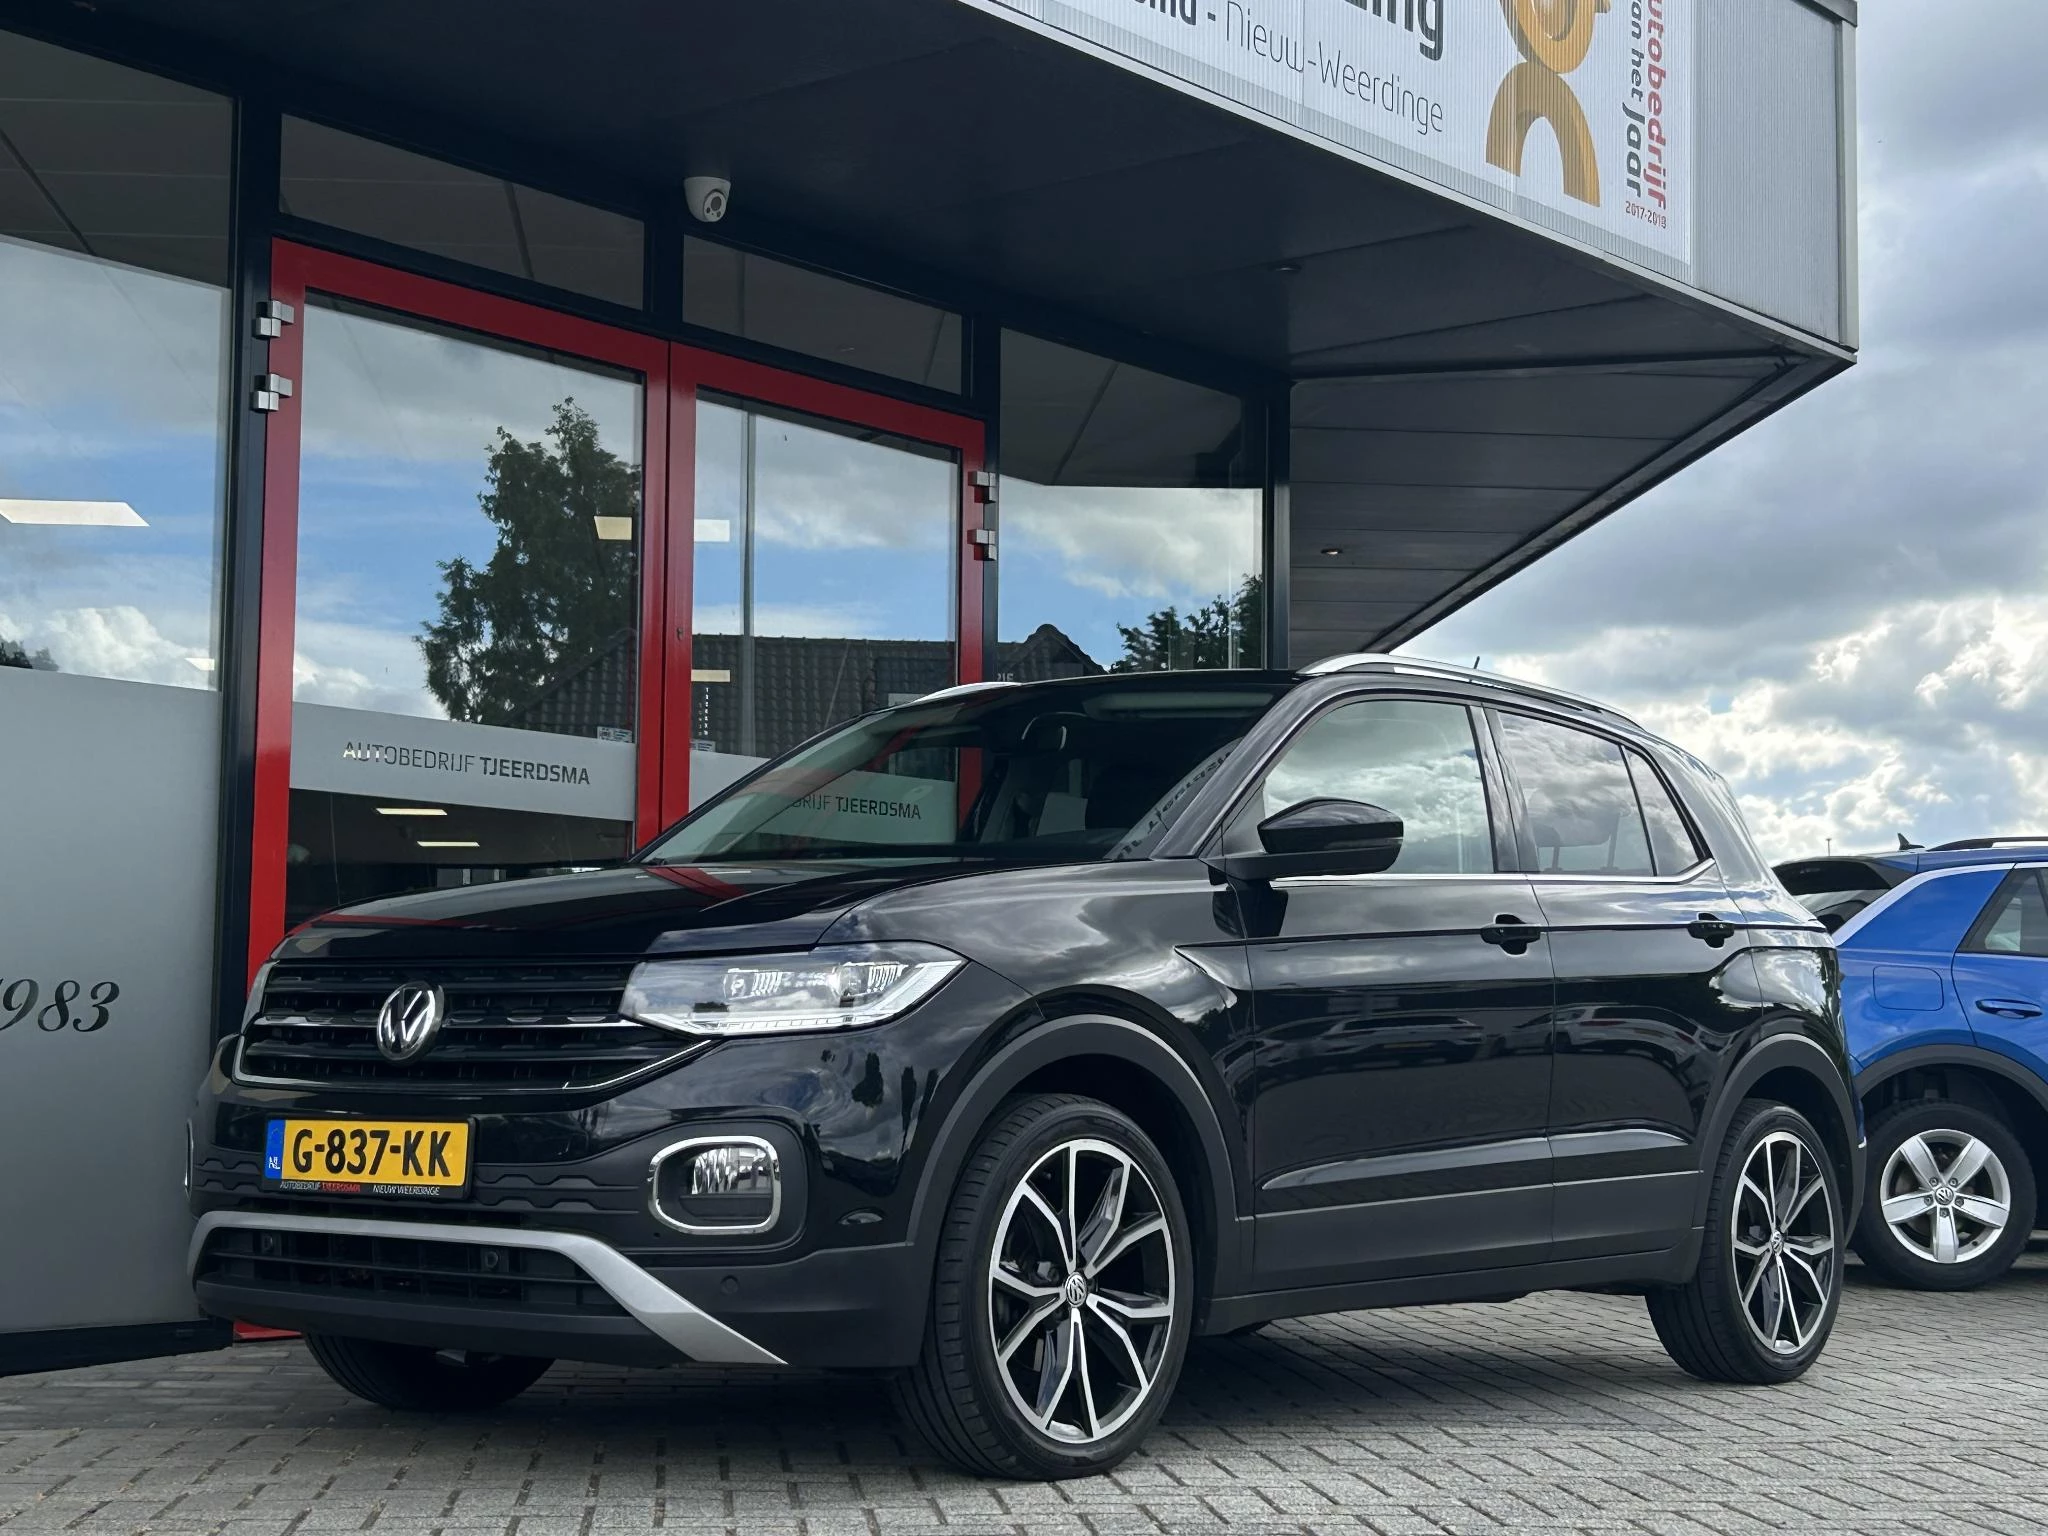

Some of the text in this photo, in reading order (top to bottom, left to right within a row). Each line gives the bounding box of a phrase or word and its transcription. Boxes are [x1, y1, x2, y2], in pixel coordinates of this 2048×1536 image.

[1631, 48, 1645, 102] het
[1643, 0, 1667, 210] utobedrijf
[343, 741, 590, 785] AUTOBEDRIJF TJEERDSMA
[835, 796, 921, 820] TJEERDSMA
[0, 978, 120, 1032] 983
[292, 1129, 451, 1177] G-837-KK
